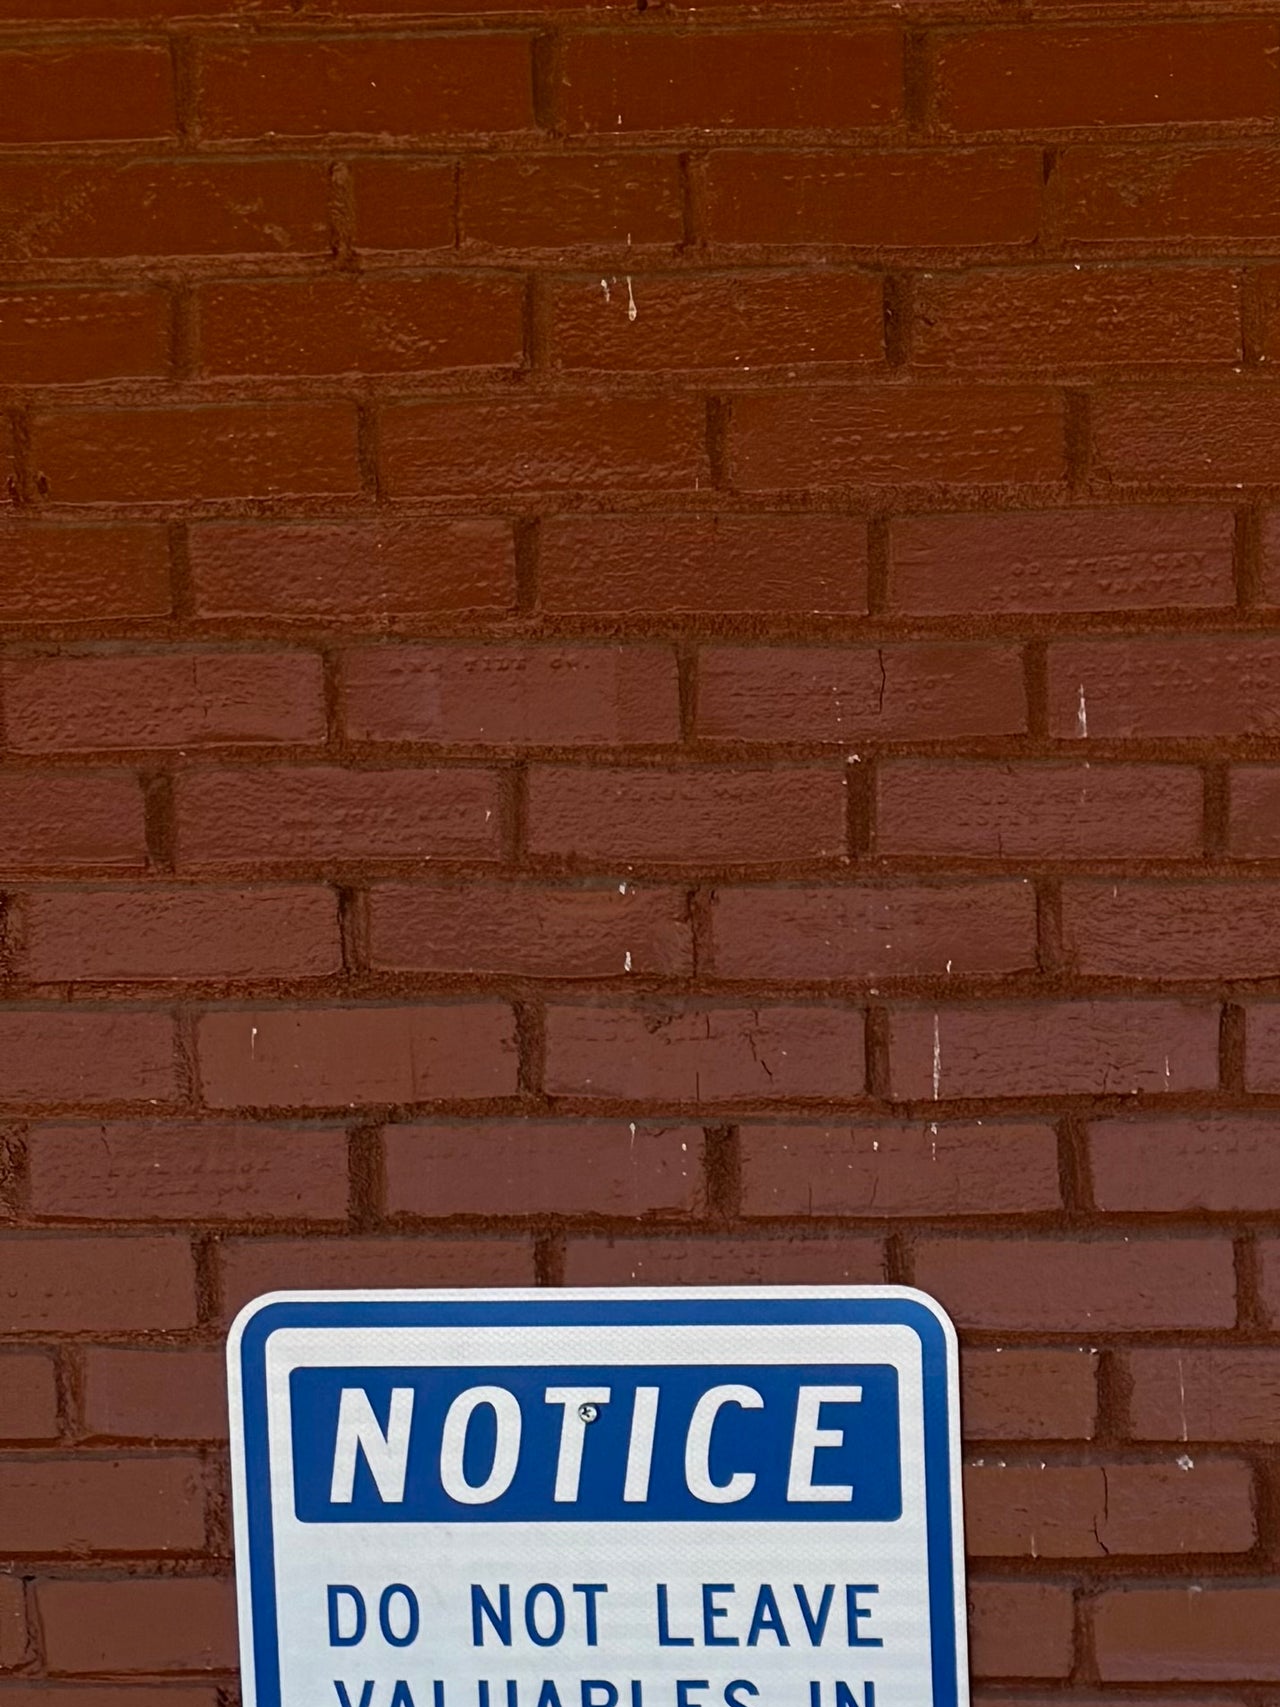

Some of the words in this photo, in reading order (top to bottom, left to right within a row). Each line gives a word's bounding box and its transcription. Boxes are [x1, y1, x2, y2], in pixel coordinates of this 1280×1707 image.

[329, 1384, 863, 1505] NOTICE
[326, 1583, 420, 1648] DO
[470, 1582, 608, 1648] NOT
[656, 1583, 884, 1648] LEAVE
